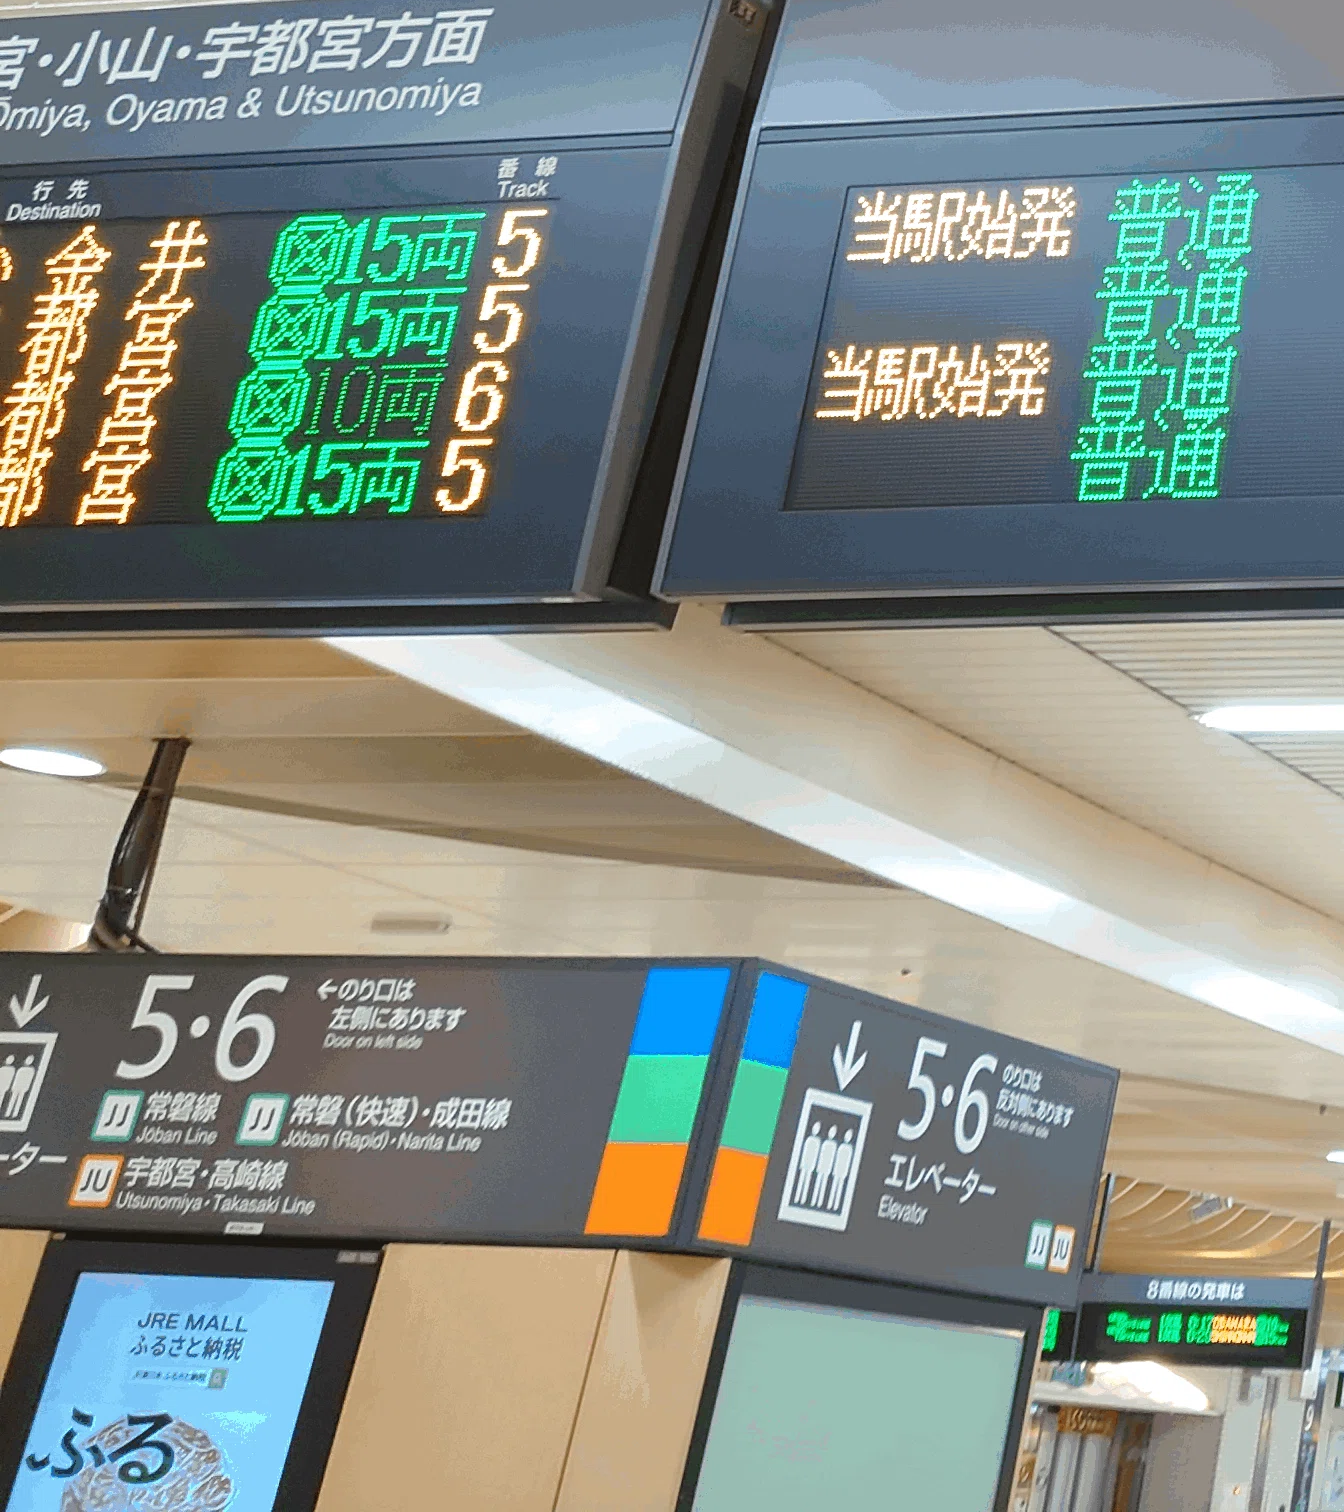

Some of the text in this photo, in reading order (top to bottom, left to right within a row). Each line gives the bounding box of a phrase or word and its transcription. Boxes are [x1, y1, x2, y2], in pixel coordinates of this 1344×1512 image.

[106, 92, 228, 132] Oyama
[236, 87, 262, 119] &
[275, 79, 482, 118] Utsunomiya
[498, 178, 548, 200] Track
[5, 202, 102, 223] Destination
[847, 185, 1076, 264] 当駅始発
[1108, 173, 1259, 265] 普通
[338, 212, 486, 285] 15両
[491, 209, 549, 279] 5
[1095, 254, 1248, 348] 普通
[317, 287, 468, 362] 15両
[473, 285, 531, 354] 5
[815, 341, 1051, 421] 当駅始発
[1083, 336, 1238, 428] 普通
[305, 363, 447, 438] 10両
[454, 360, 508, 433] 6
[1070, 414, 1226, 502] 普通
[280, 440, 431, 515] 15両
[435, 438, 494, 514] 5
[338, 978, 416, 1003] のり口は
[328, 1004, 467, 1032] 左側にあります
[1002, 1064, 1043, 1093] のり口は
[104, 1102, 133, 1128] JJ
[143, 1090, 222, 1124] 常磐線
[250, 1105, 278, 1132] JJ
[184, 1127, 218, 1145] Line
[446, 1134, 482, 1153] Line
[80, 1165, 114, 1192] JU
[884, 1153, 997, 1205] エレベーター
[282, 1195, 317, 1216] Line
[877, 1194, 929, 1226] Elevator
[1032, 1235, 1046, 1256] JJ
[1054, 1238, 1069, 1260] JU
[137, 1312, 248, 1333] JRE MALL
[129, 1335, 244, 1361] ふるさと納税
[1304, 1404, 1315, 1432] 9
[25, 1405, 175, 1484] ふる
